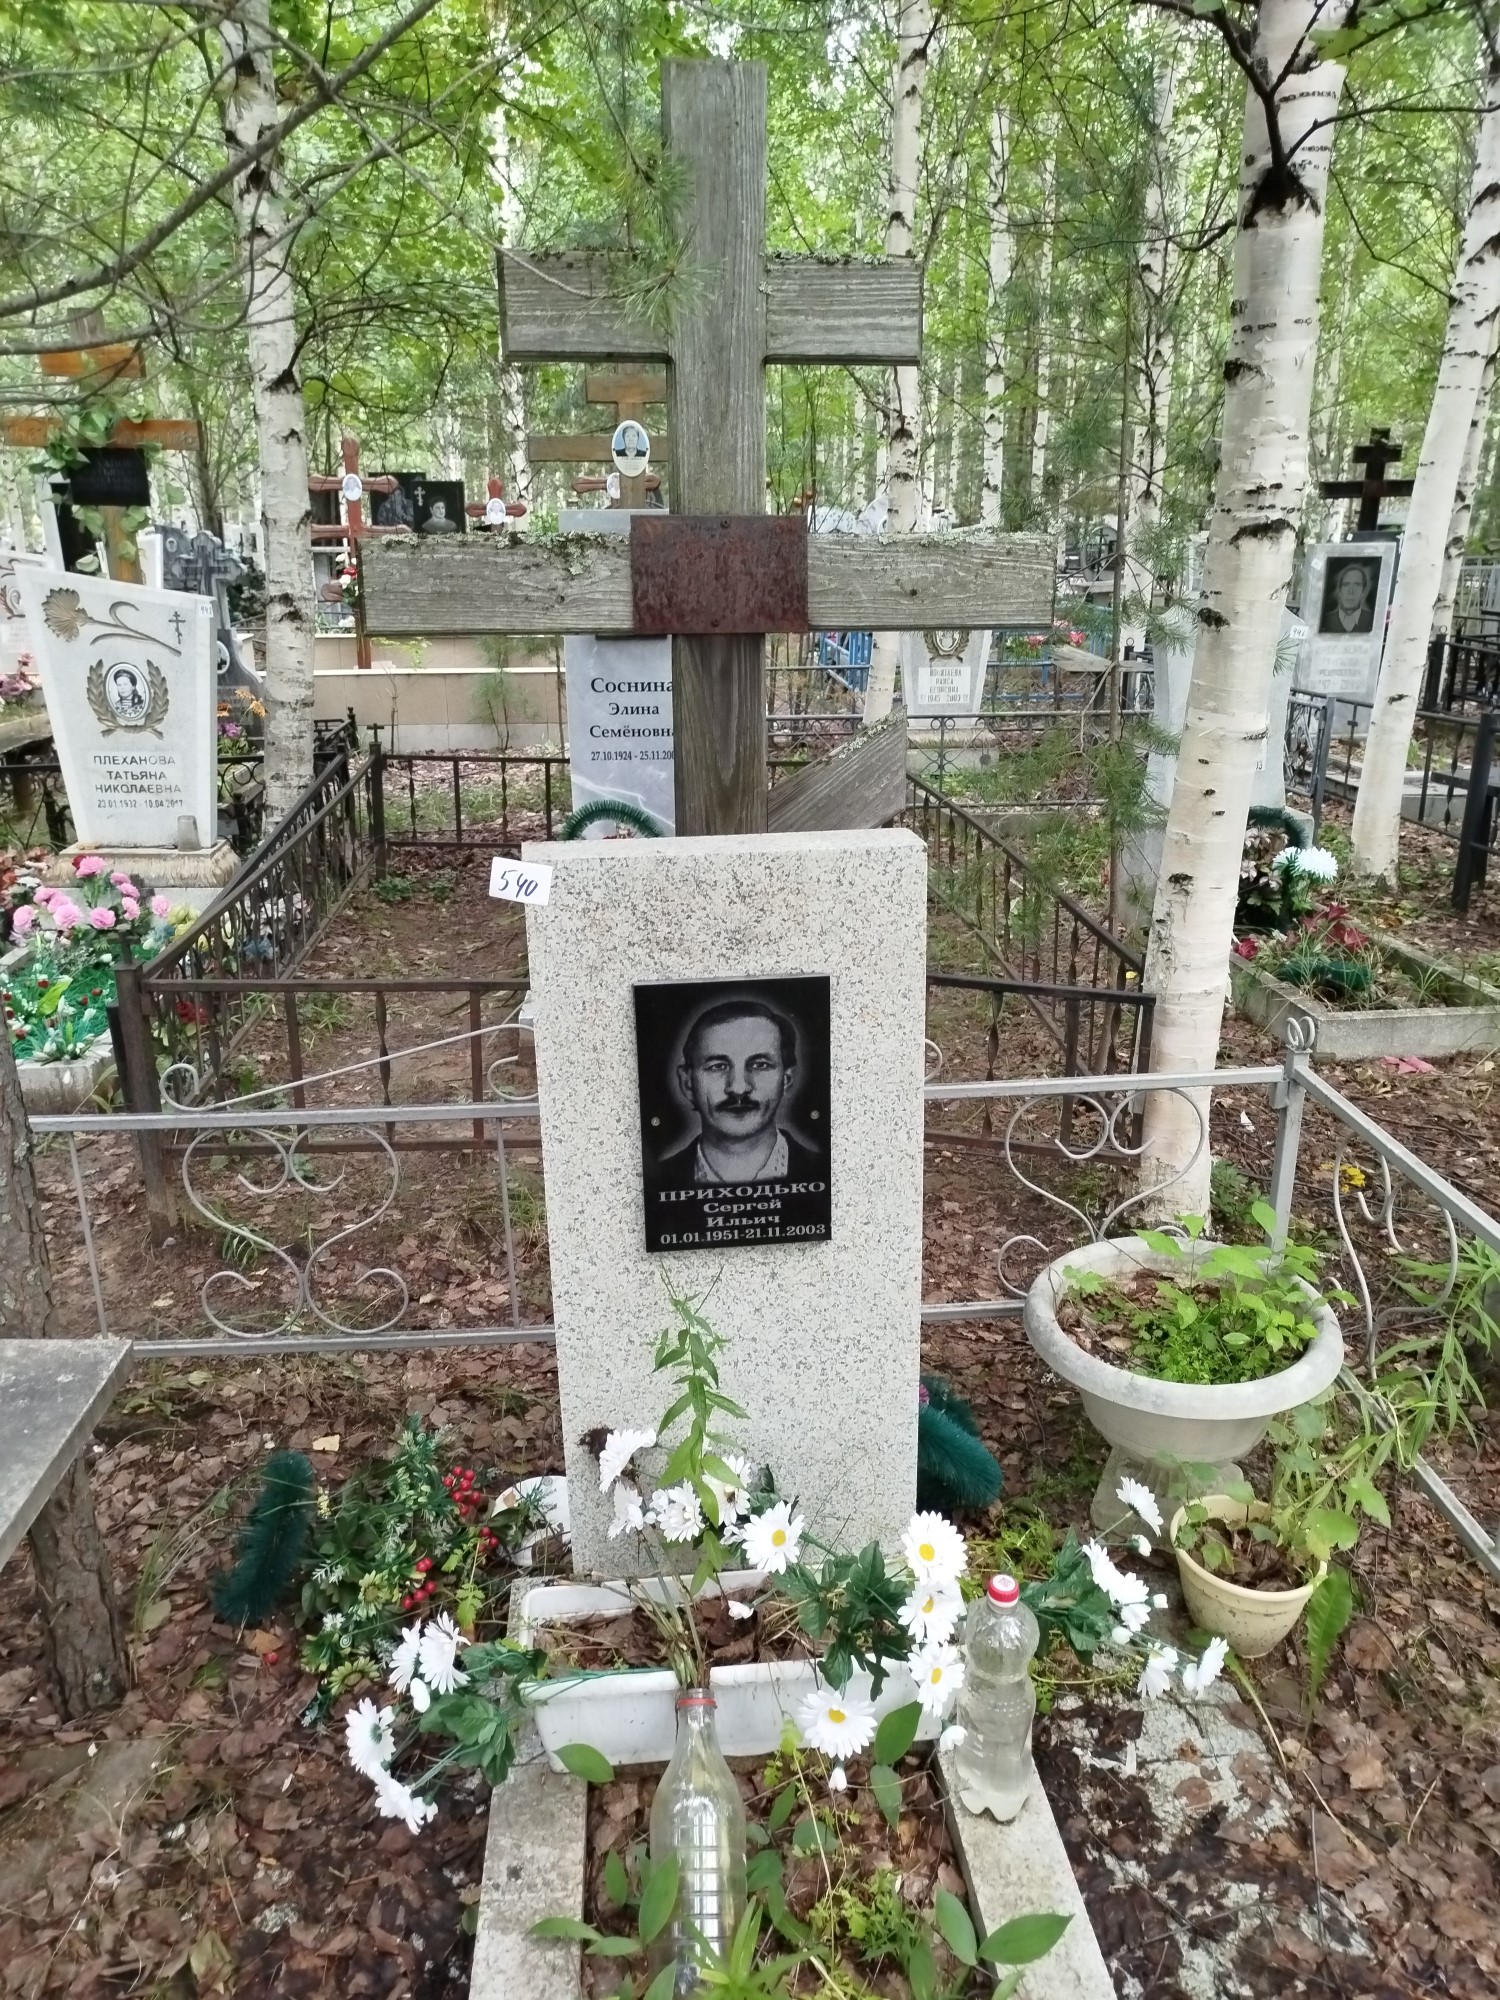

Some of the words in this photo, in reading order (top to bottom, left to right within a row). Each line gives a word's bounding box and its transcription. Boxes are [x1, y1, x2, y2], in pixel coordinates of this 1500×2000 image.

[590, 677, 673, 693] Соснина
[608, 702, 660, 716] Элина
[589, 724, 674, 738] Семёновн
[93, 755, 176, 765] ПЛЕХАНОВА
[591, 751, 632, 761] 27.10.1924
[106, 770, 168, 780] ТАТЬЯНА
[95, 784, 182, 794] НИКОЛАЕВНА
[498, 870, 539, 899] 540
[658, 1181, 826, 1202] ПРИХОДЬКО
[703, 1198, 782, 1214] Сергей
[705, 1215, 781, 1228] Ильич
[660, 1224, 826, 1244] 01.01.1951-21.11.2003
